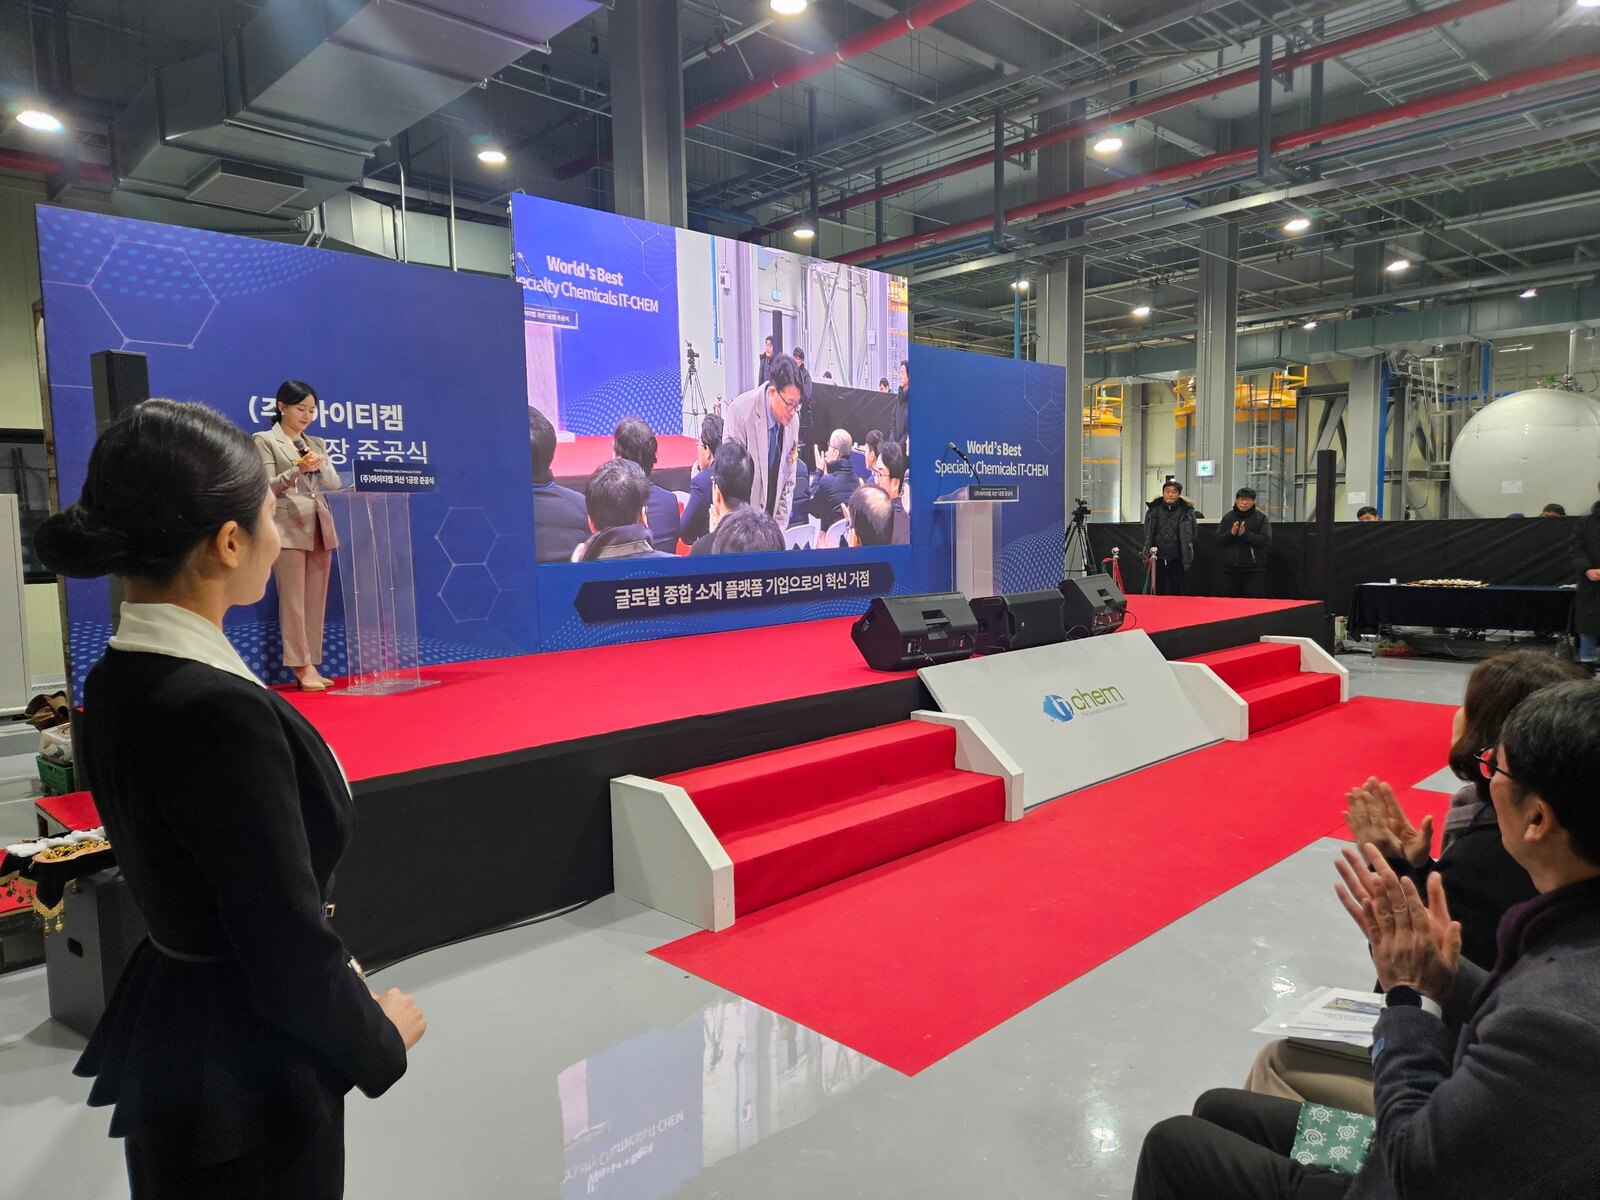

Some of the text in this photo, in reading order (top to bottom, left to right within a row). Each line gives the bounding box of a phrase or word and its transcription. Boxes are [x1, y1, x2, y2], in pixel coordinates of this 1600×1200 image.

[597, 267, 624, 287] Best
[516, 275, 659, 313] ecialty Chemicals IT-CHEM
[1002, 442, 1022, 457] Best
[935, 459, 1049, 477] Specialty Chemicals IT-CHEM
[615, 570, 870, 609] 글로벌 종합 소재 플랫폼 기업으로의 혁신 거점
